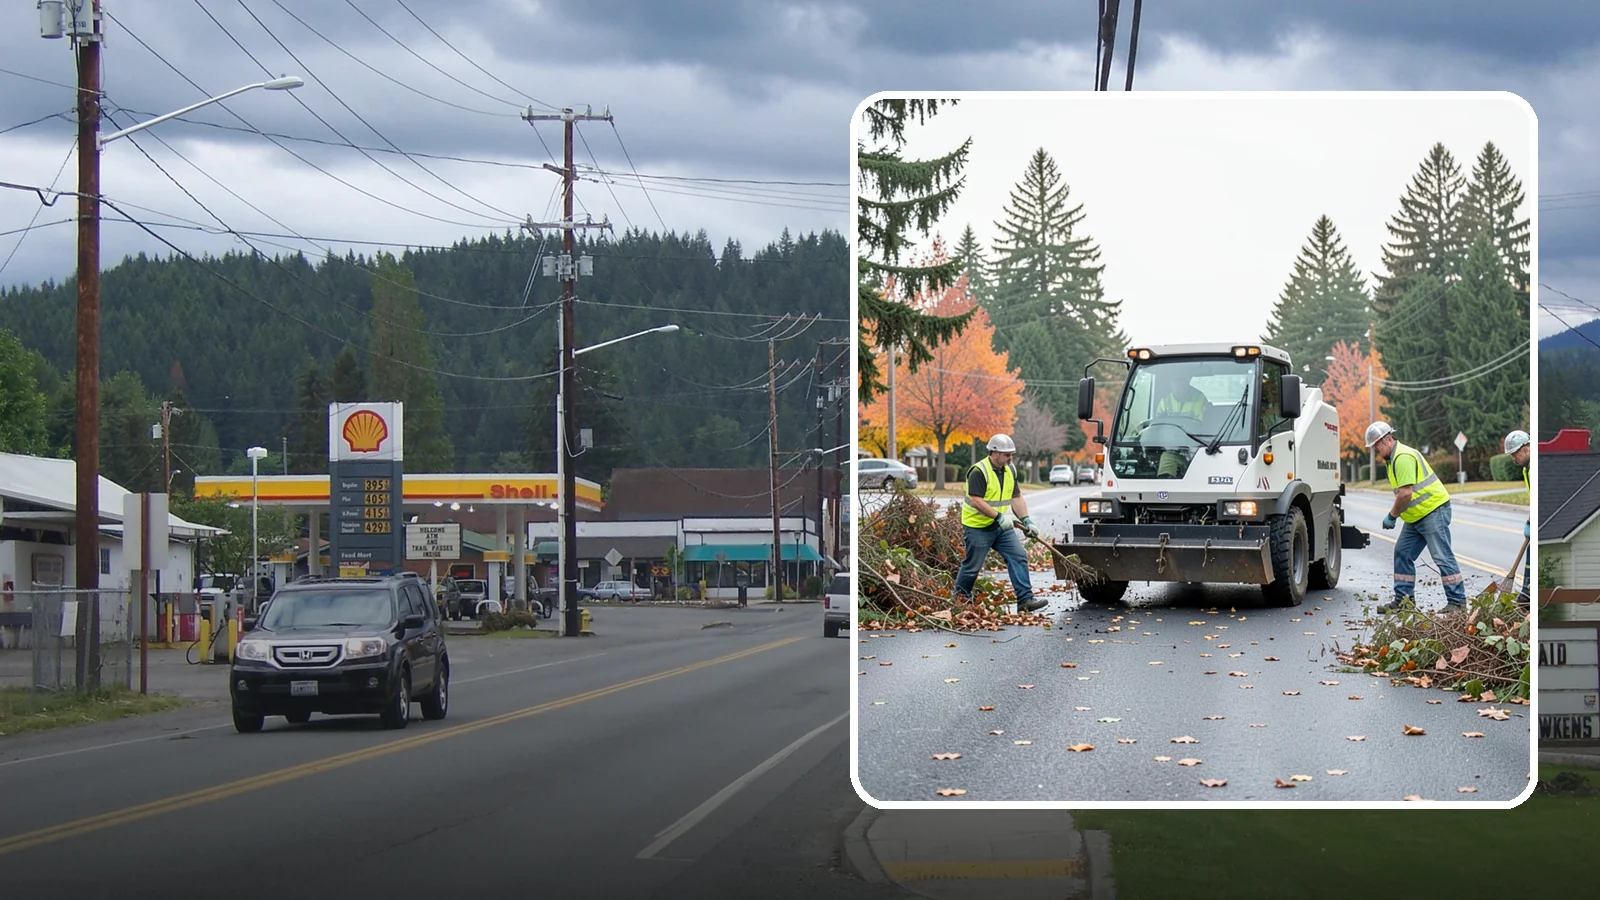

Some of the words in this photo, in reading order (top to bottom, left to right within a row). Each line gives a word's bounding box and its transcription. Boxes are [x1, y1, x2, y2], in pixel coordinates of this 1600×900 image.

[365, 480, 383, 490] 395
[490, 484, 547, 499] Shell
[365, 494, 383, 504] 405
[365, 508, 383, 518] 415
[365, 522, 383, 532] 429
